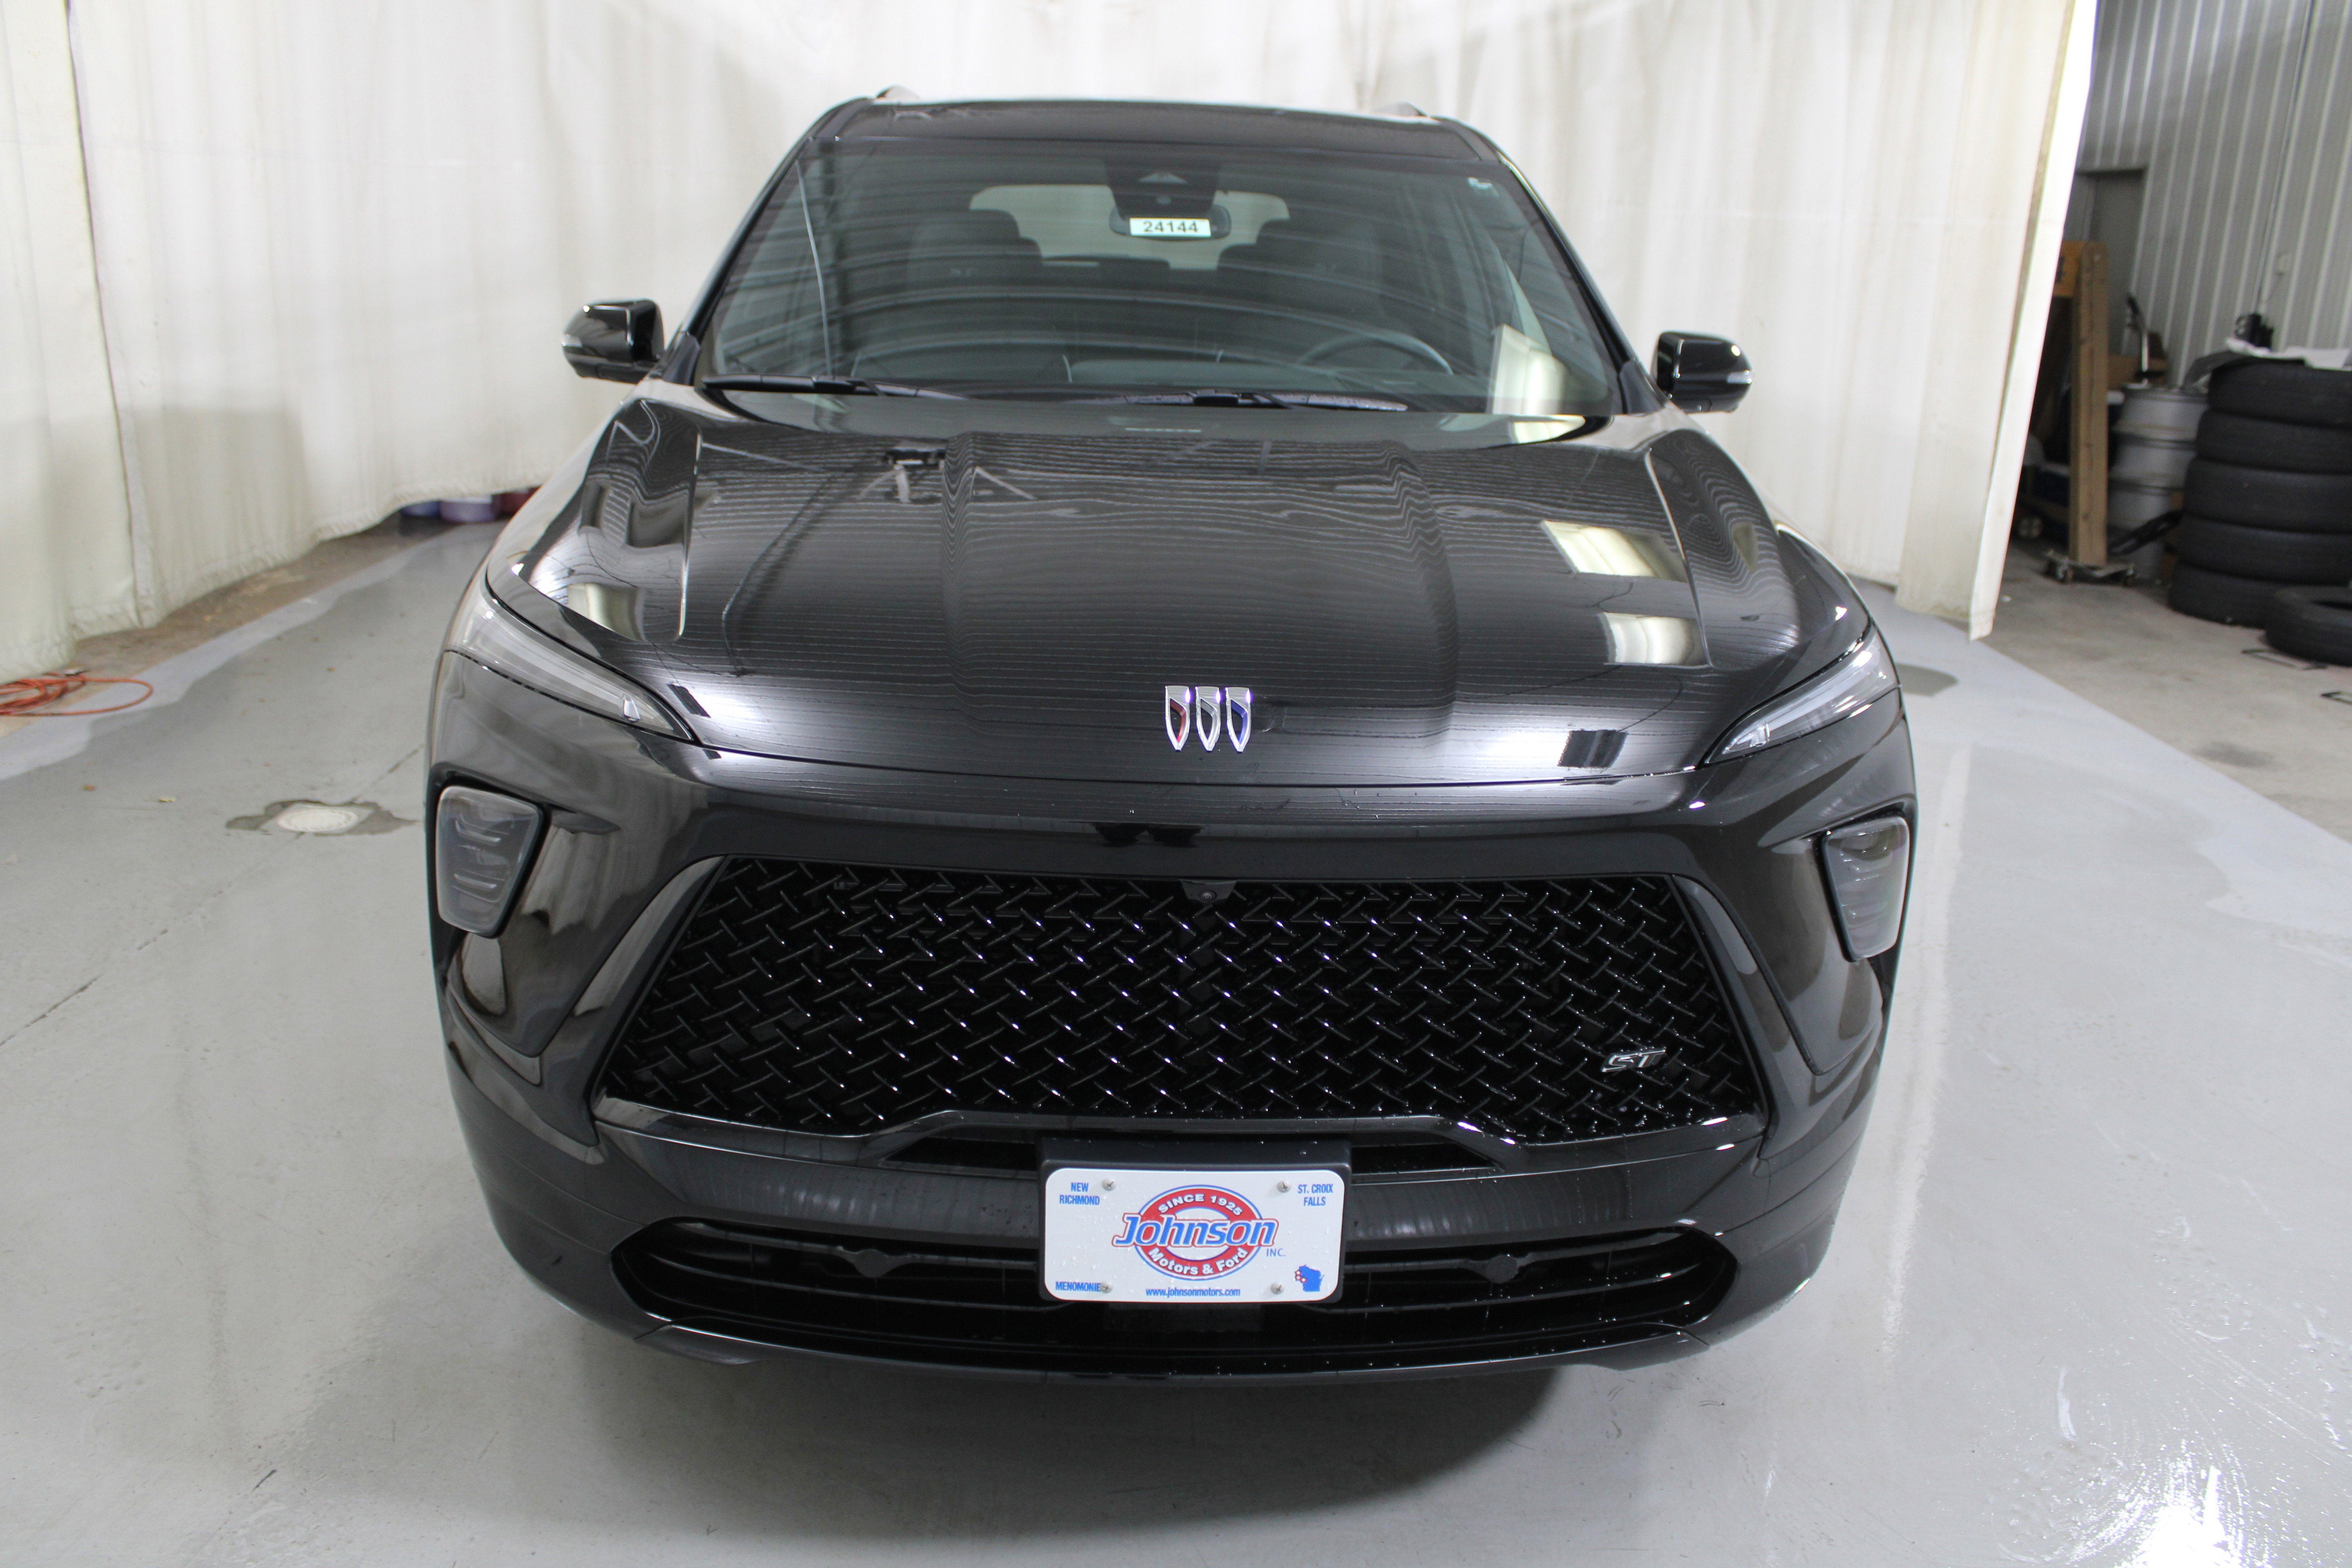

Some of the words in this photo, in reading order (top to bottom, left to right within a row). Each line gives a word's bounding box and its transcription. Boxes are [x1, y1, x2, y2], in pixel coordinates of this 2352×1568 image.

[1143, 220, 1198, 233] 24144
[1071, 1183, 1089, 1192] NEW
[1298, 1184, 1309, 1194] ST.
[1312, 1184, 1334, 1194] CROIX
[1059, 1194, 1100, 1205] RICHMOND
[1158, 1194, 1205, 1214] SINCE
[1210, 1195, 1243, 1216] 1925
[1303, 1196, 1326, 1206] FALLS
[1114, 1214, 1277, 1246] Johnson
[1266, 1248, 1286, 1257] INC.
[1147, 1247, 1199, 1275] Motors
[1202, 1263, 1214, 1274] &
[1216, 1247, 1249, 1272] Ford
[1055, 1281, 1101, 1292] MENOMONIE
[1145, 1287, 1241, 1298] www.johnsonmotors.com
